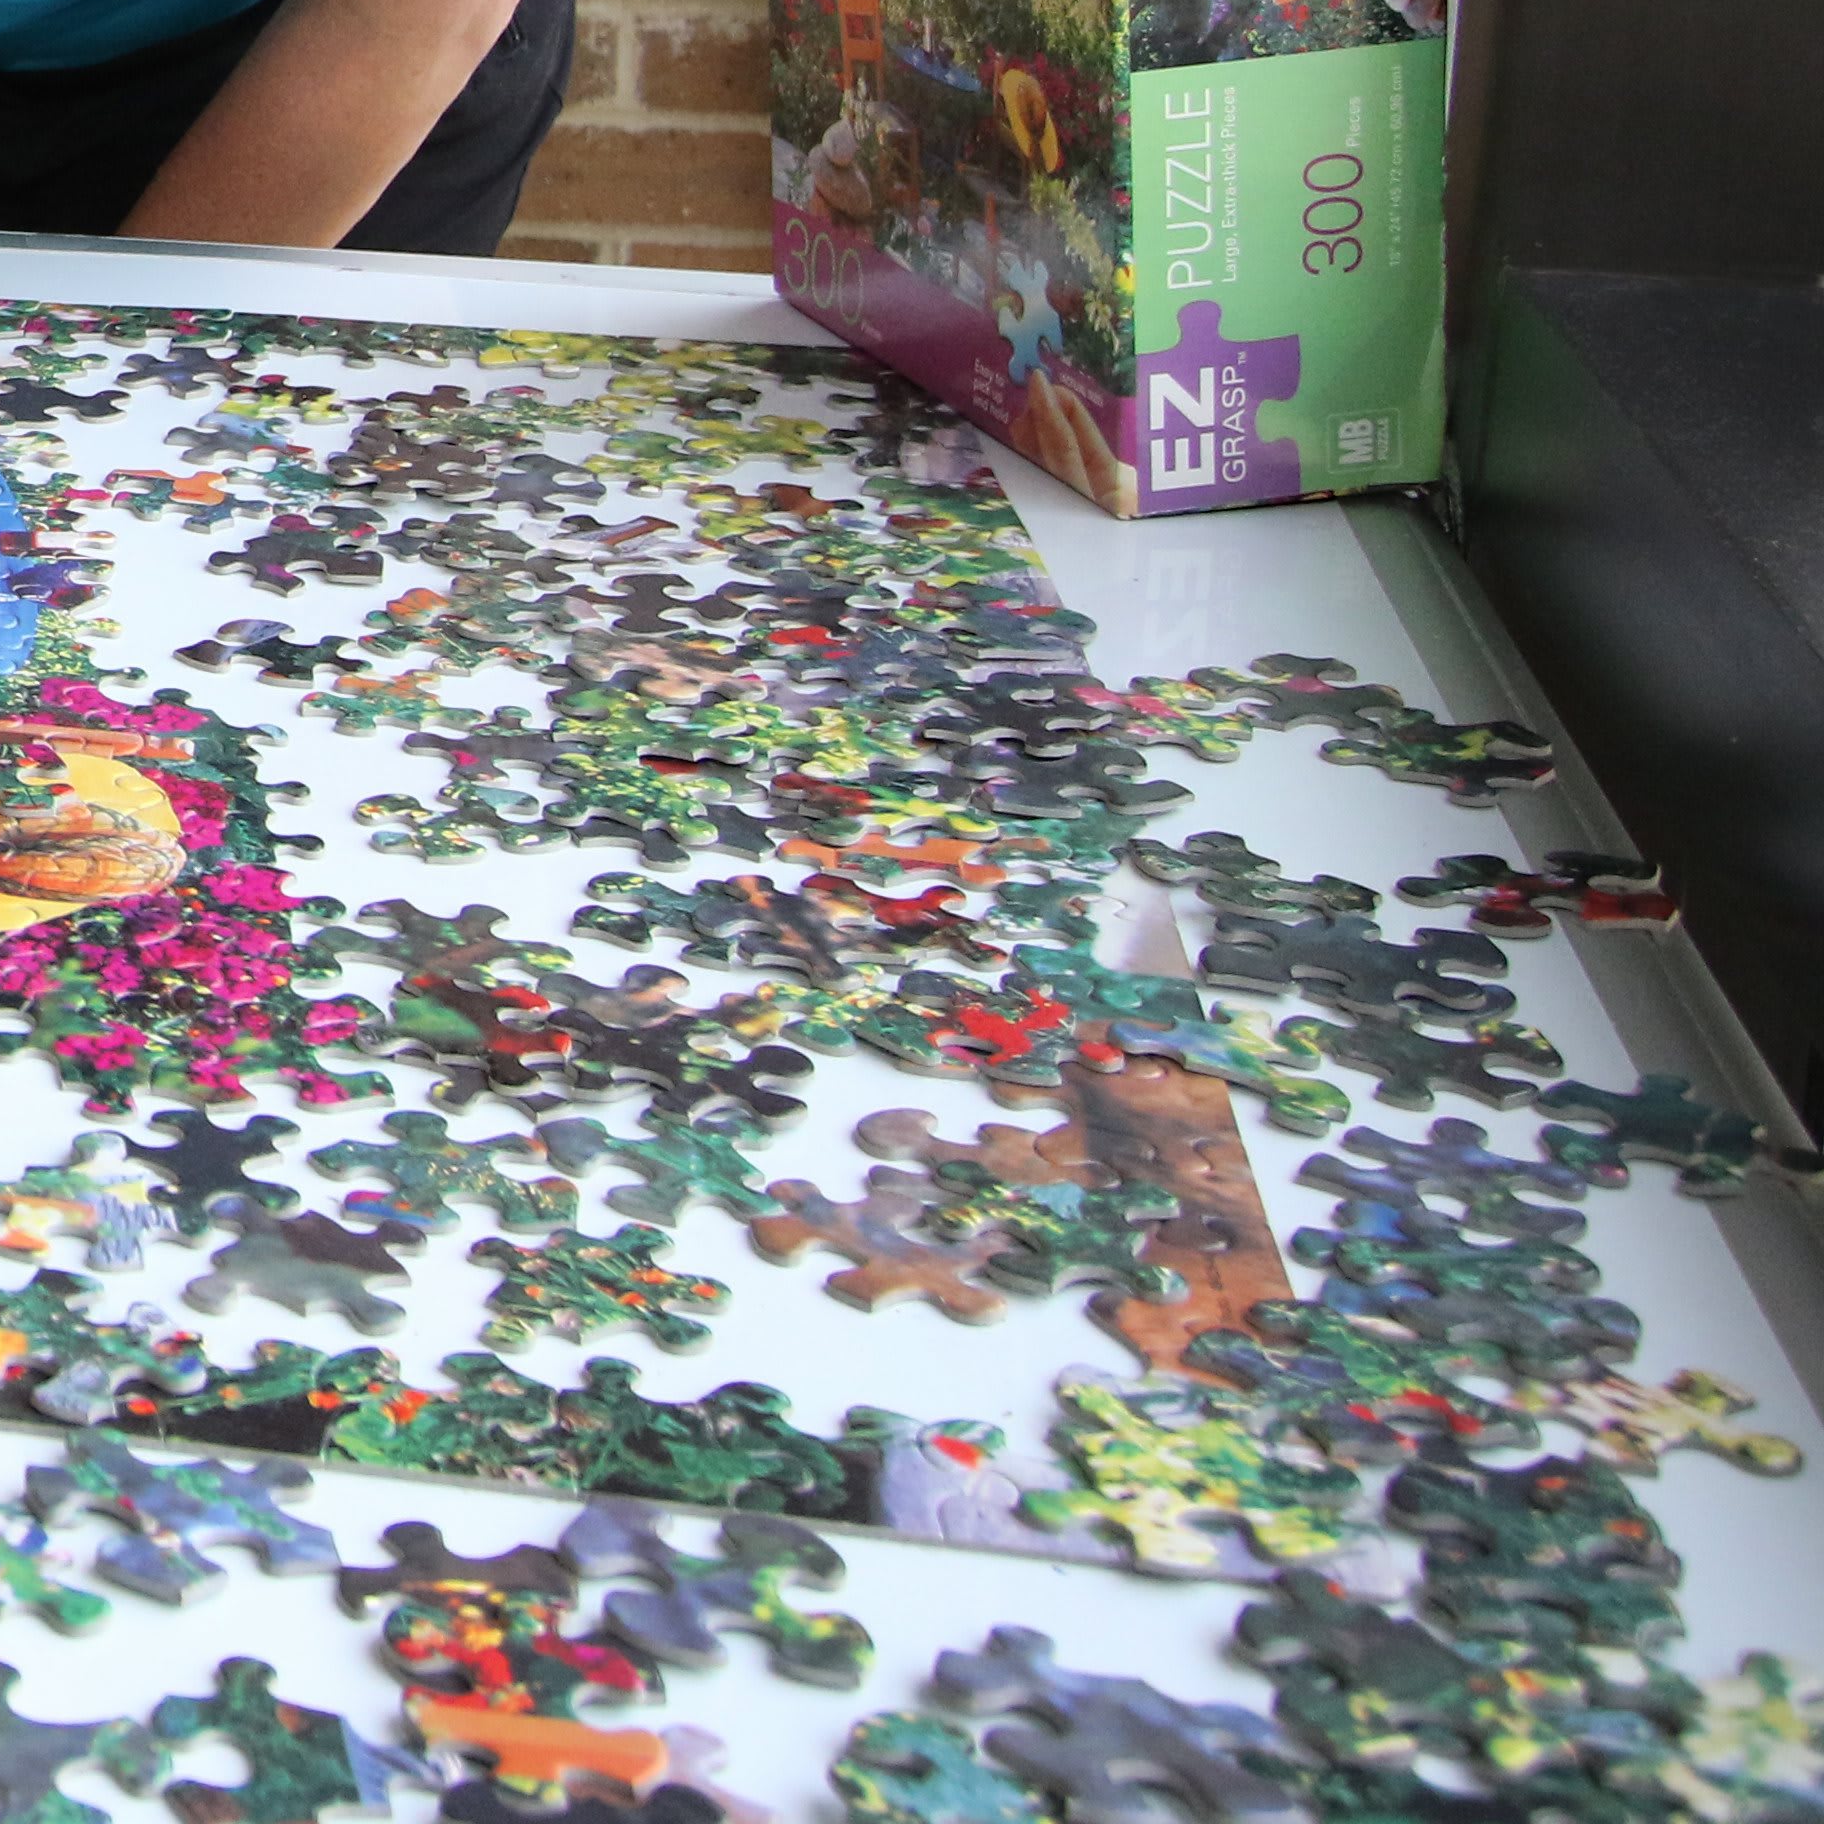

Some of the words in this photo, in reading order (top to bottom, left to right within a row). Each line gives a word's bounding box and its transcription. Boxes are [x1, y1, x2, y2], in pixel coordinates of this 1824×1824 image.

[1220, 86, 1236, 140] Pieces
[1164, 88, 1213, 289] PUZZLE
[1221, 141, 1236, 229] Extra-thick
[1302, 153, 1364, 275] 300
[1345, 96, 1362, 148] Pieces
[783, 218, 865, 325] 300
[1221, 230, 1240, 283] Large,
[1149, 366, 1215, 492] EZ
[1221, 365, 1247, 483] GRASP
[1338, 418, 1374, 466] MB
